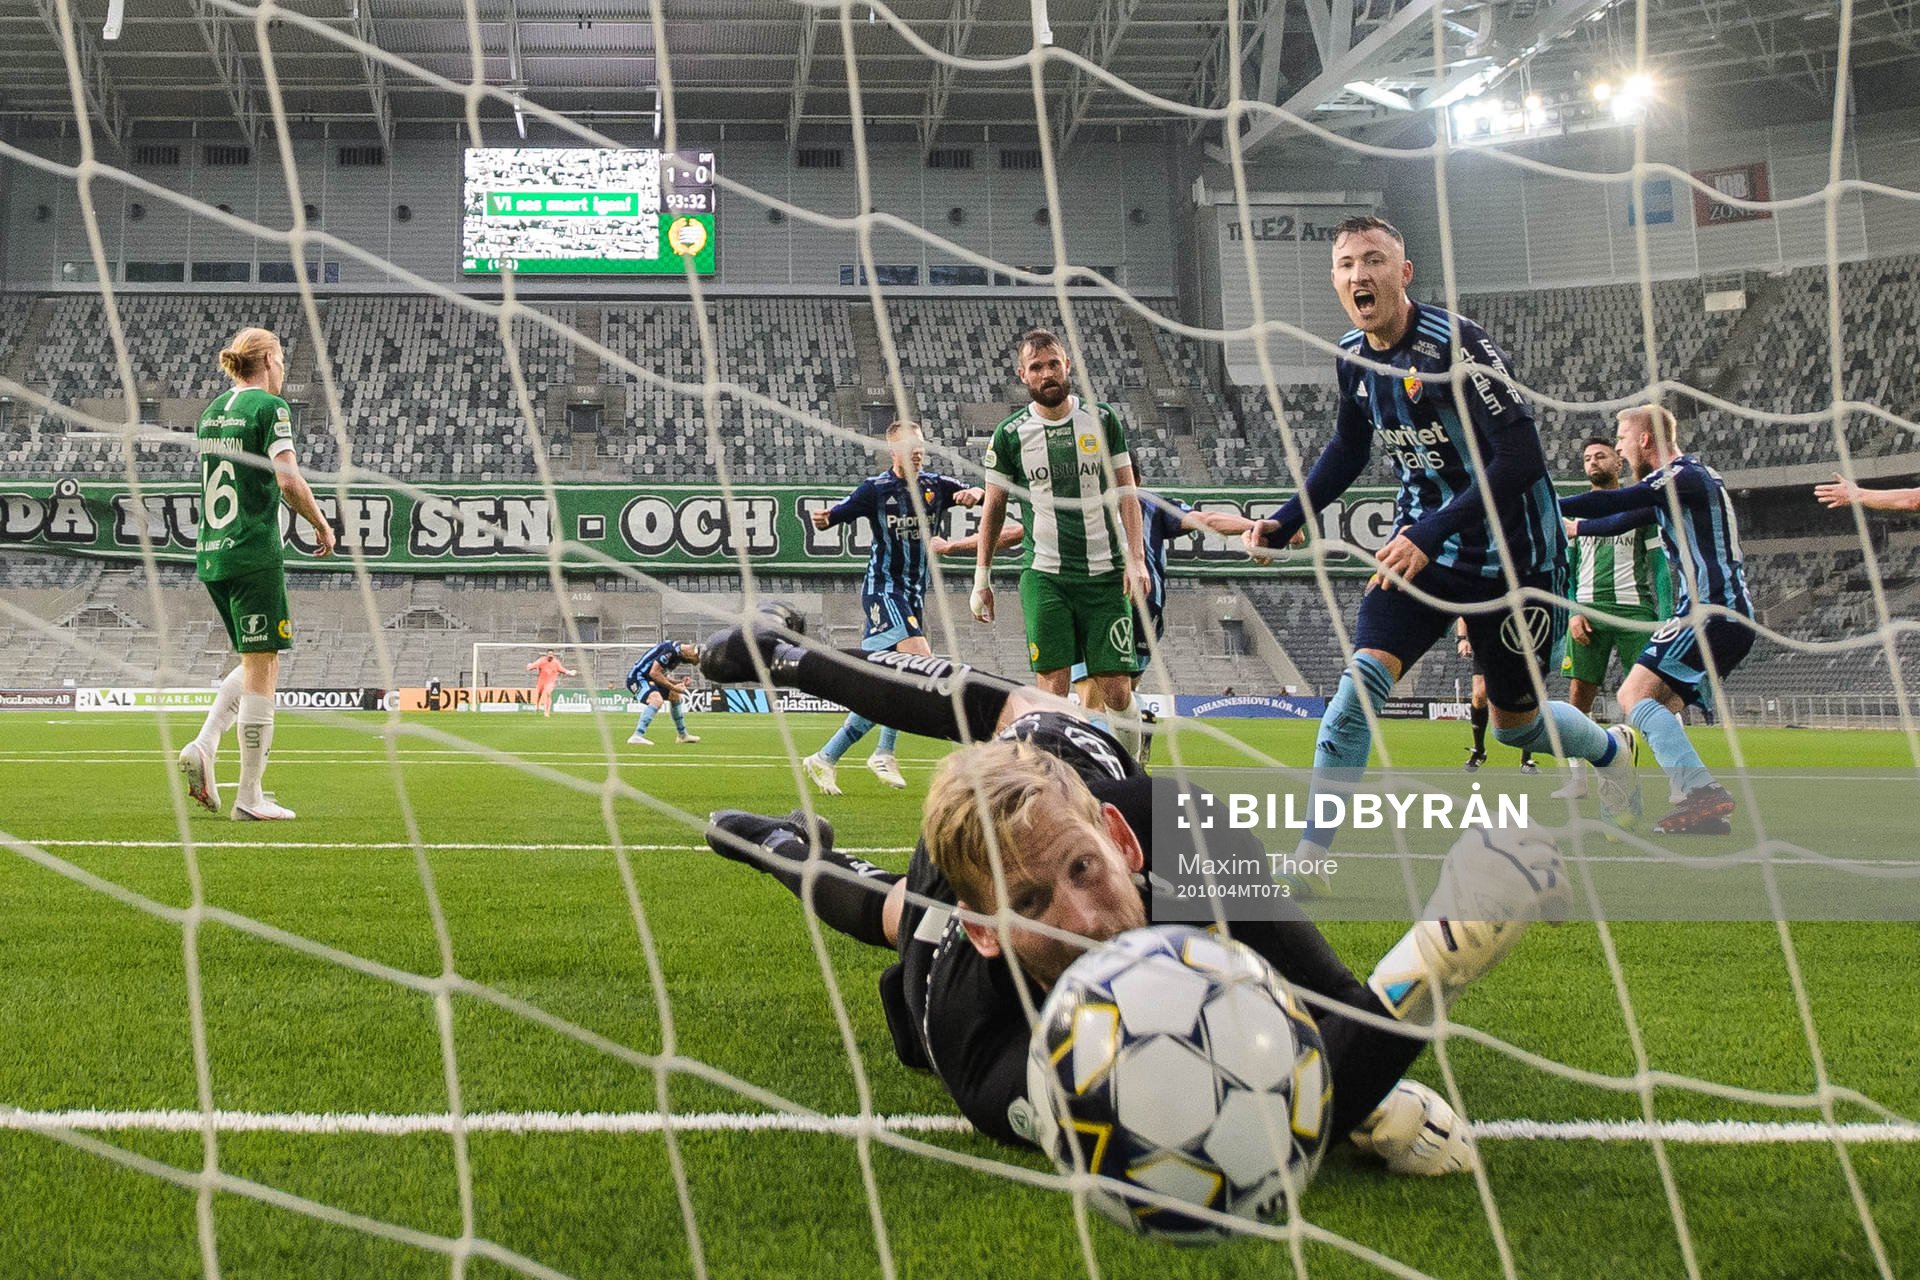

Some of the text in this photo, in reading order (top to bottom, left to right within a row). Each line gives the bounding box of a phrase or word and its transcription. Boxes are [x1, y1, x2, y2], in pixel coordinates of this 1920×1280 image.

[666, 166, 675, 183] 1
[695, 165, 707, 183] 0
[666, 193, 706, 209] 93:32
[4, 480, 96, 542] DÅ
[411, 496, 554, 556] SEN
[621, 495, 779, 557] OCH
[54, 694, 70, 705] AB
[80, 691, 131, 706] RIVAL
[145, 693, 212, 704] RIVARE.NU
[1294, 707, 1308, 718] AB
[1429, 702, 1472, 720] DICKENS
